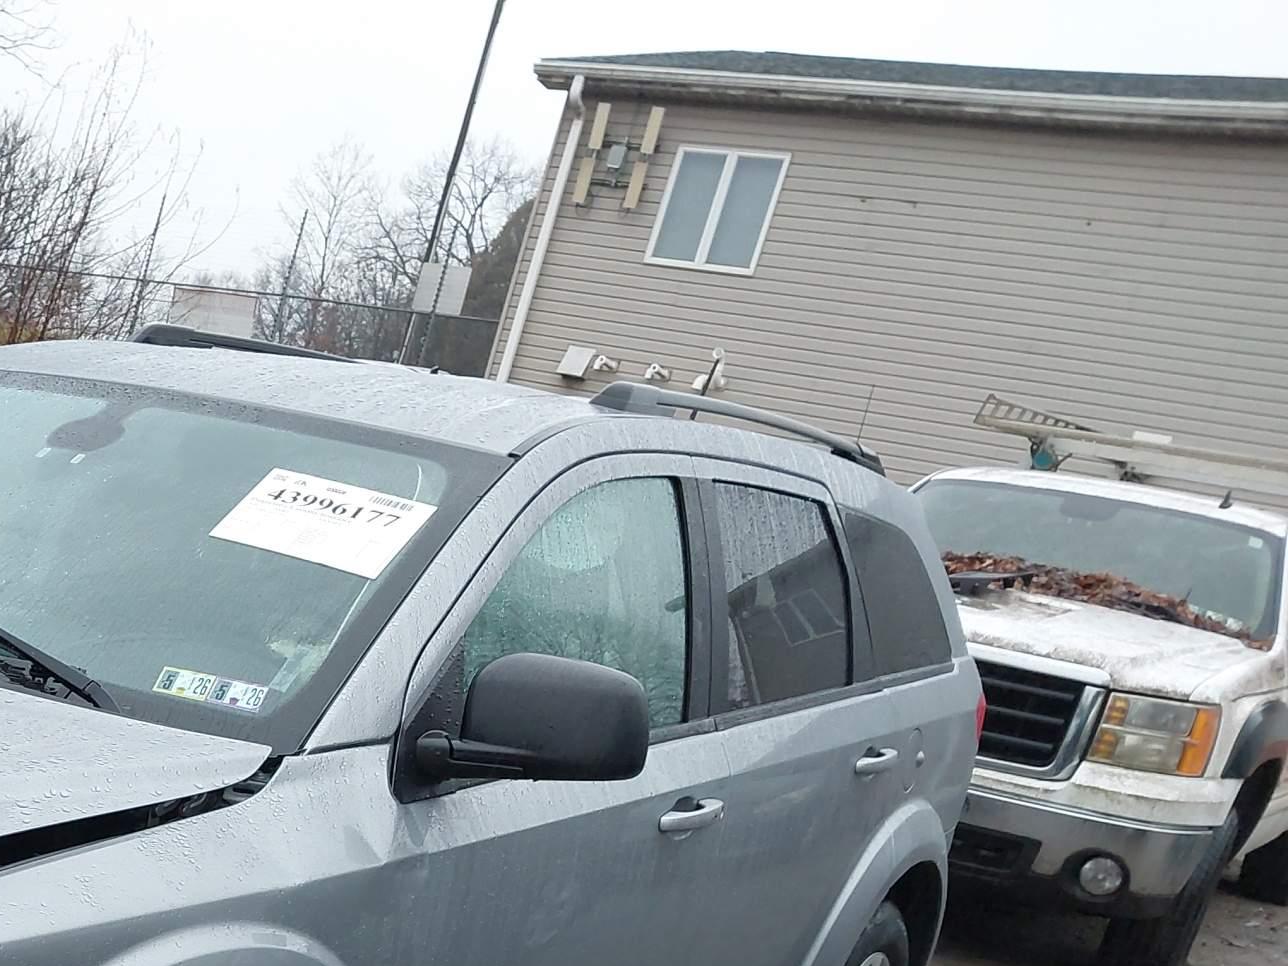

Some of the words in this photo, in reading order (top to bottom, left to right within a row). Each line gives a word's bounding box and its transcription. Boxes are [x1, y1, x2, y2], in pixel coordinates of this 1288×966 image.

[267, 488, 401, 527] 43996177
[193, 677, 212, 696] 26
[246, 688, 265, 707] 26
